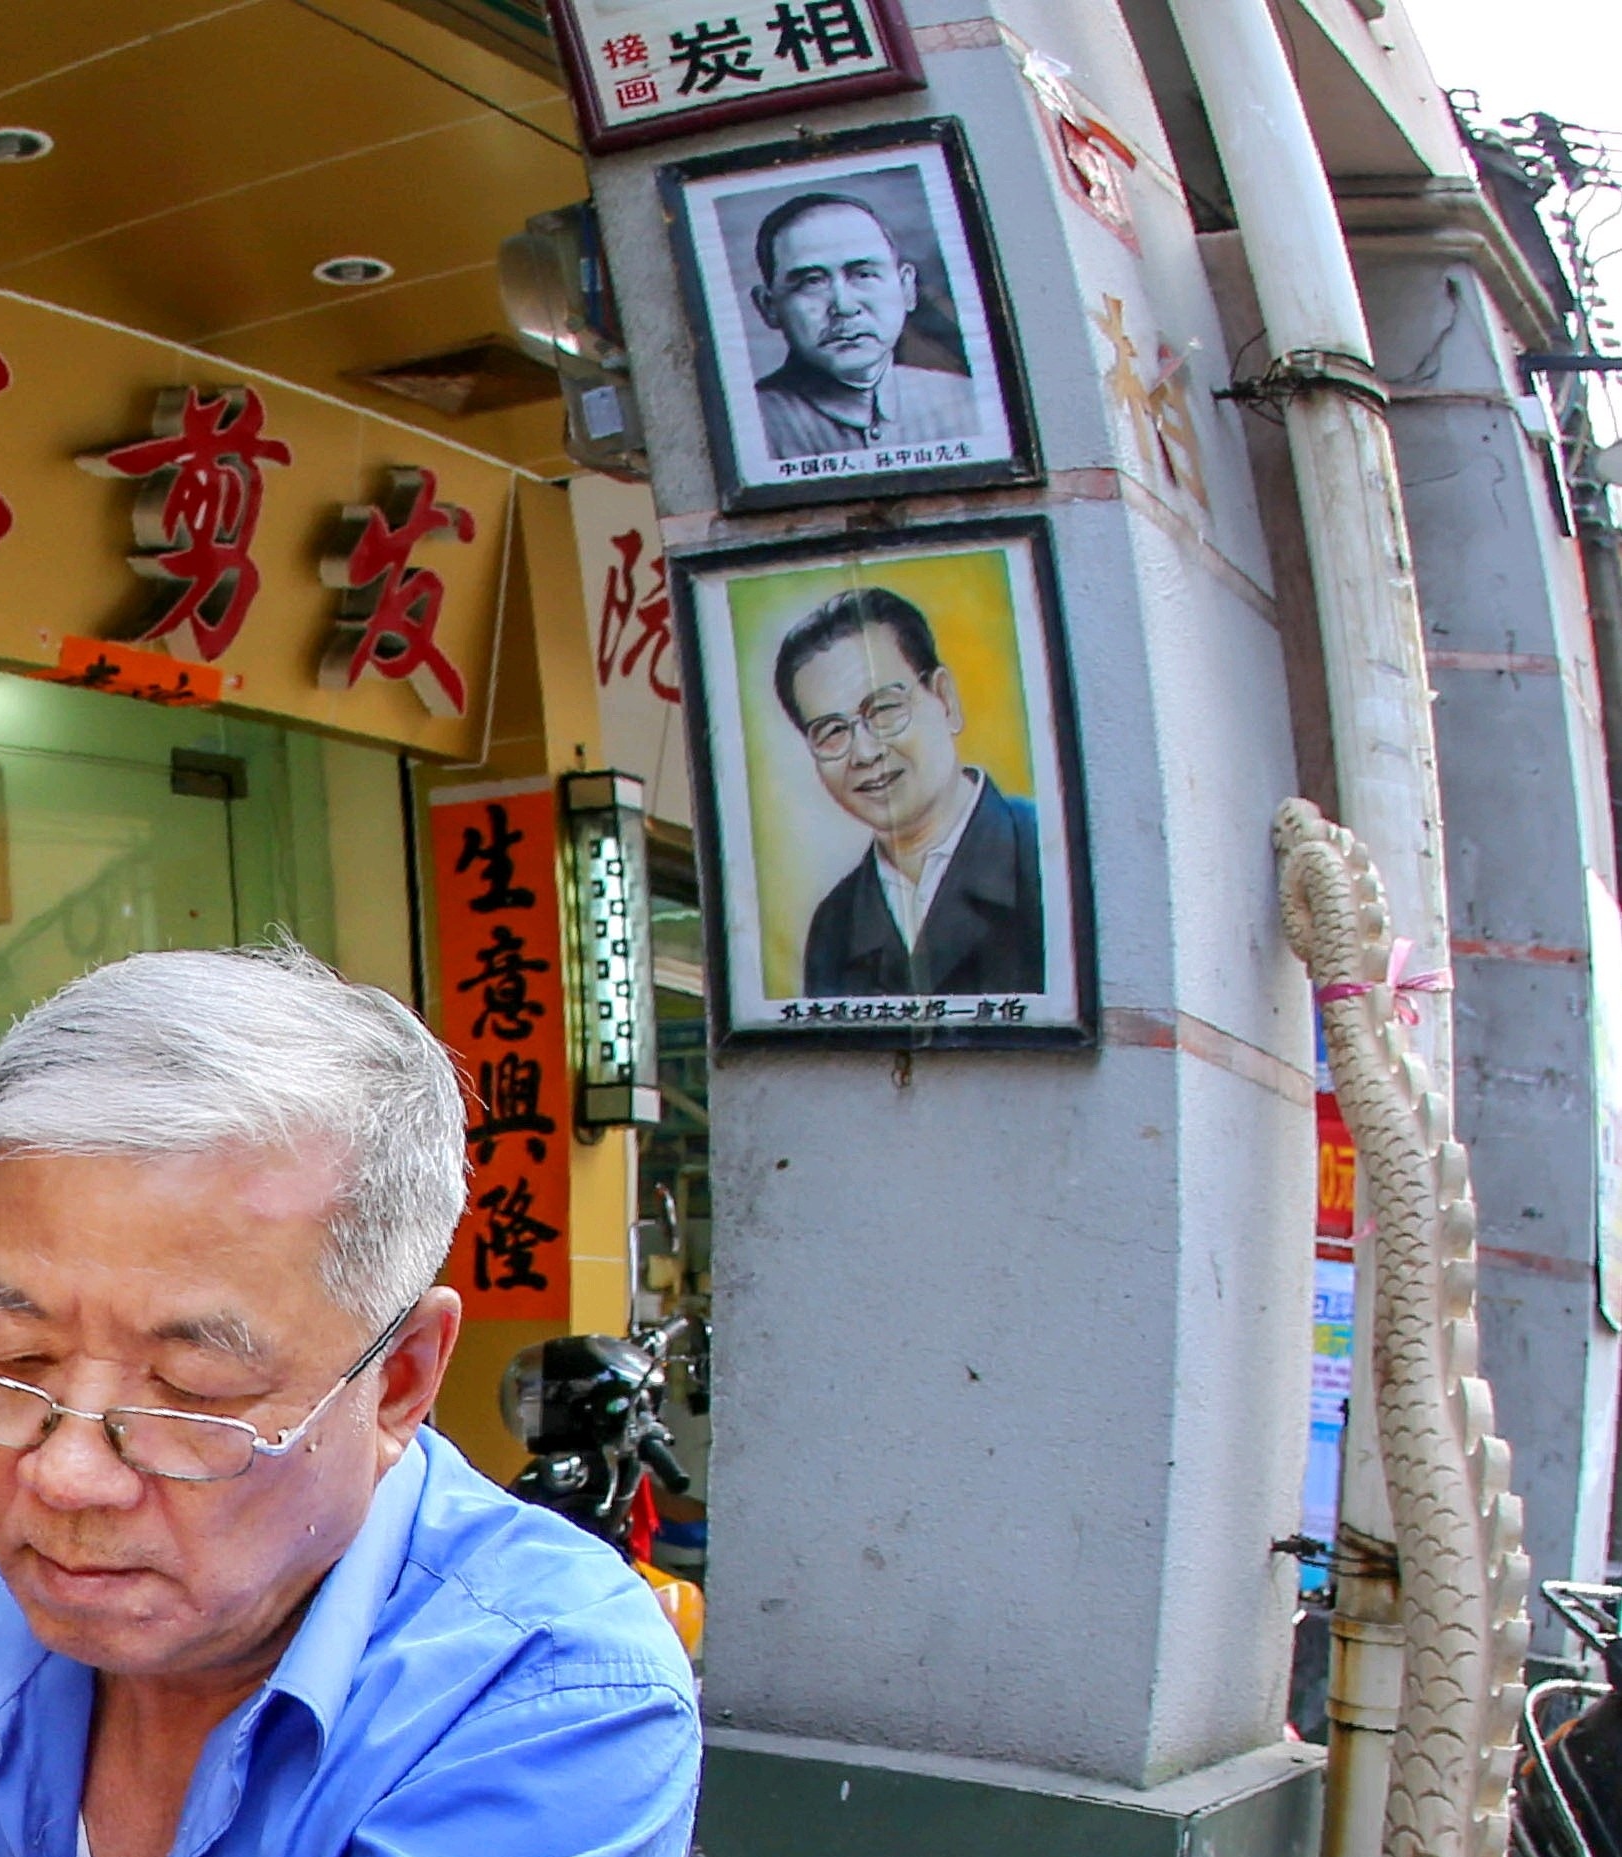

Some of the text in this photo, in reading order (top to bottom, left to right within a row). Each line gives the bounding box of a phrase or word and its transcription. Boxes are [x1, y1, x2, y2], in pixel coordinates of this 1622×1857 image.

[601, 32, 659, 109] 接画
[668, 0, 874, 96] 炭相
[455, 803, 561, 1292] 生意興隆
